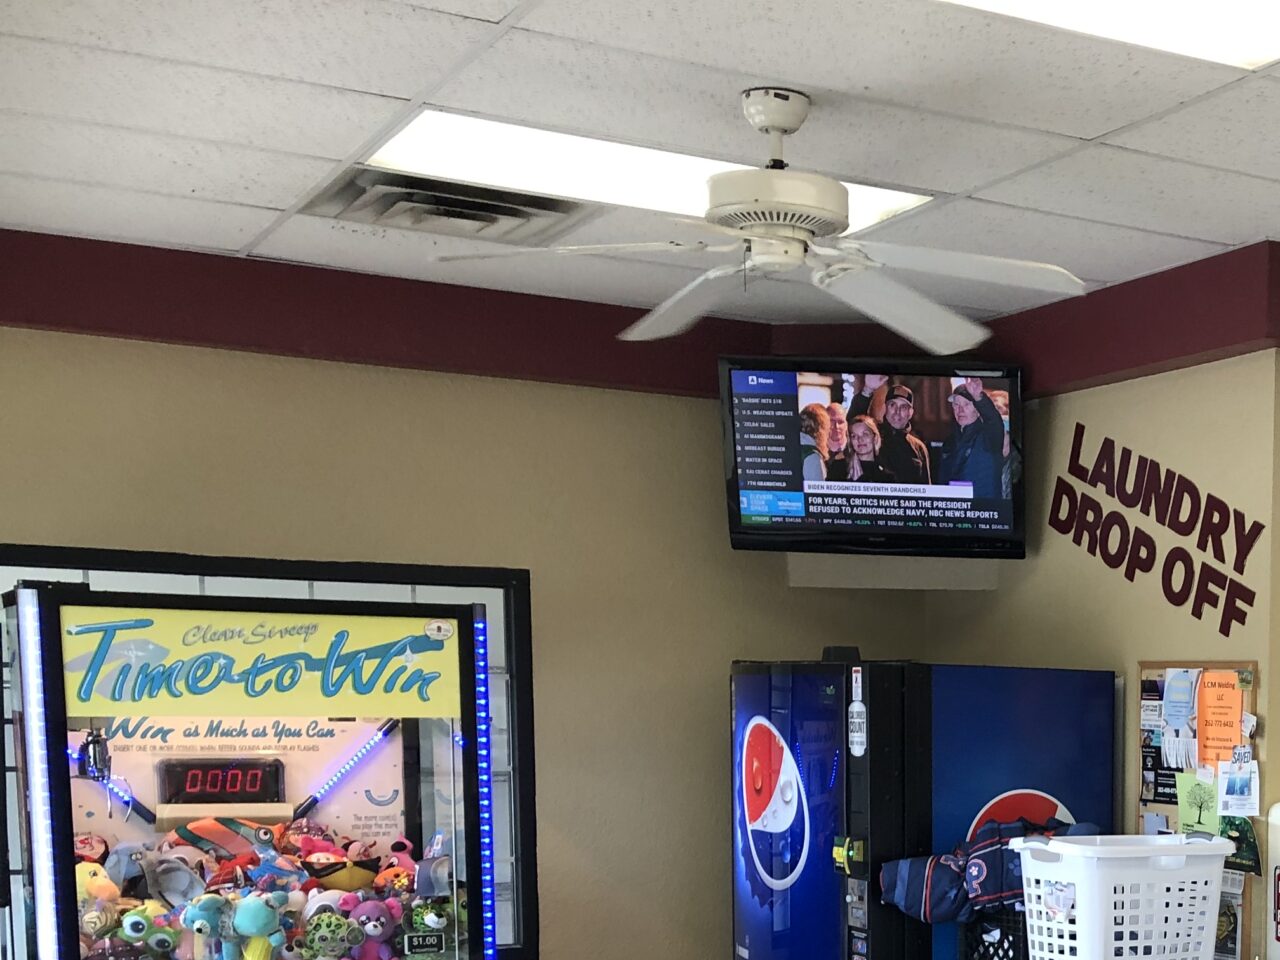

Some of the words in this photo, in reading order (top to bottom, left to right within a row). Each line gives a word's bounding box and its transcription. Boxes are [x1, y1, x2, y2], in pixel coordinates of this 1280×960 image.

[809, 496, 823, 505] FOR
[824, 497, 849, 507] YEARS,
[850, 498, 878, 506] CRITICS
[879, 499, 899, 507] HAVE
[900, 499, 917, 508] SAID
[918, 500, 932, 508] THE
[933, 500, 972, 510] PRESIDENT
[1068, 421, 1266, 576] LAUNDRY
[809, 505, 840, 514] REFUSED
[841, 506, 851, 514] TO
[852, 506, 905, 516] ACKNOWLEDGE
[905, 509, 928, 518] NAVY,
[945, 510, 965, 518] NEWS
[966, 511, 999, 519] REPORTS
[1048, 475, 1157, 583] DROP
[1162, 546, 1257, 638] OFF
[183, 624, 244, 647] Clean
[243, 620, 320, 645] Sweep
[67, 618, 236, 702] Time
[244, 651, 306, 699] to
[320, 630, 444, 701] Win
[105, 716, 175, 743] Win
[183, 726, 201, 738] as
[204, 719, 248, 738] Much
[251, 726, 268, 738] as
[272, 720, 302, 743] You
[306, 720, 335, 738] Can
[849, 721, 865, 734] COUNT
[1232, 751, 1251, 765] SAVED
[185, 768, 263, 794] 0000
[412, 936, 437, 946] $1.00
